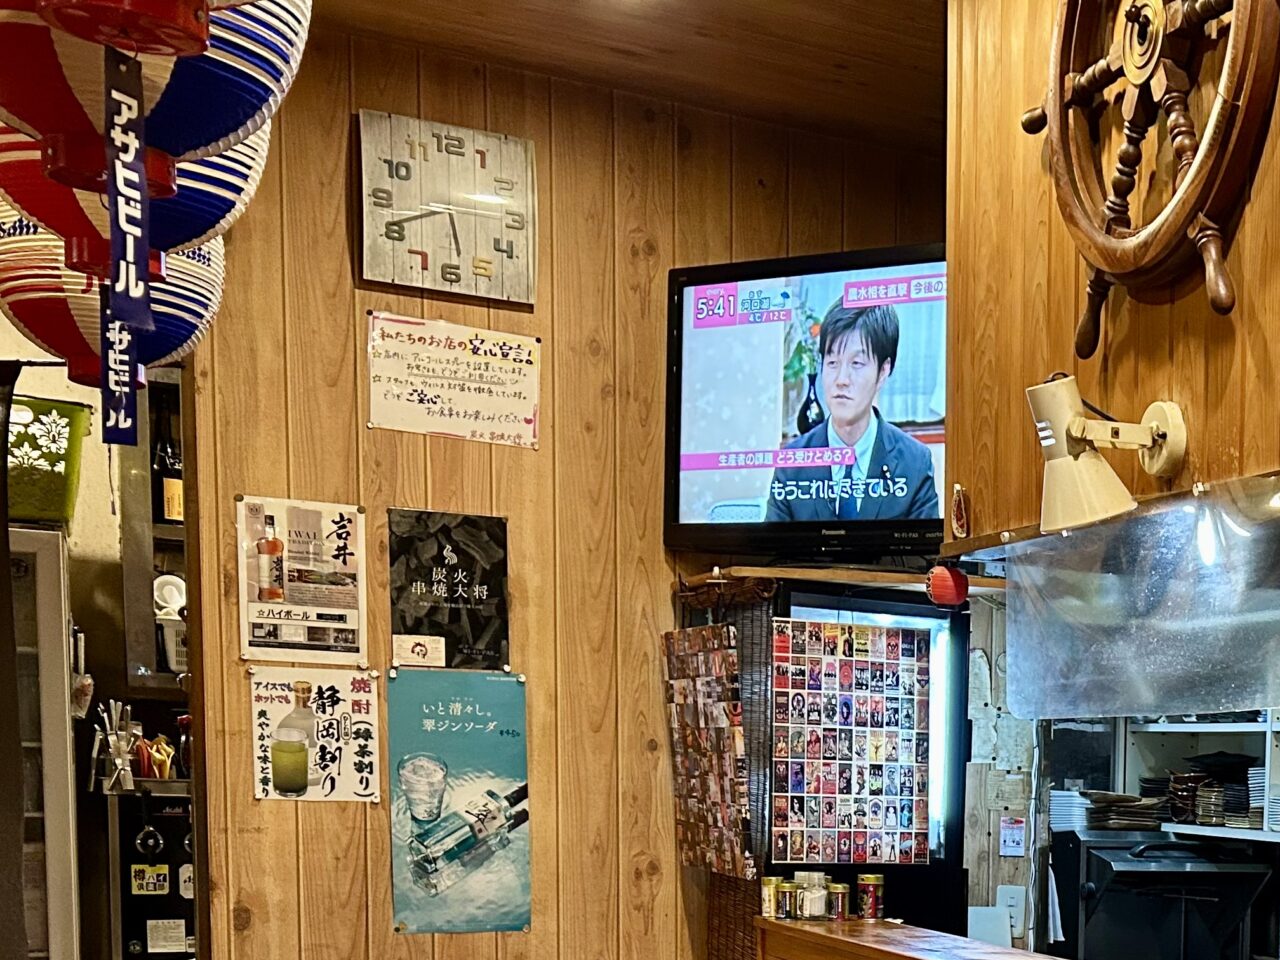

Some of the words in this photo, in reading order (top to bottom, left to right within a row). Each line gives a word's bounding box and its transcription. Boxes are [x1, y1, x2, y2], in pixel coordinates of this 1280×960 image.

[405, 138, 430, 162] 11
[432, 133, 465, 157] 12
[383, 158, 412, 181] 10
[475, 148, 487, 169] 1
[110, 90, 145, 298] アサヒビール
[371, 187, 393, 208] 9
[494, 177, 514, 198] 2
[505, 209, 525, 231] 3
[385, 221, 406, 242] 8
[407, 248, 429, 270] 7
[493, 238, 514, 260] 4
[441, 262, 462, 284] 6
[472, 256, 494, 278] 5
[696, 294, 736, 320] 5:41
[771, 477, 908, 501] もうこれに尽きている
[326, 512, 356, 566] 岩井
[431, 567, 469, 583] 炭火
[411, 581, 489, 600] 串焼大将
[266, 608, 311, 621] ハイボール
[254, 681, 294, 693] アイスでも
[350, 676, 372, 715] 焼酎
[254, 694, 291, 704] ホットでも
[422, 701, 493, 717] いと清々し。
[422, 718, 499, 732] 翠ジンソーダ
[310, 684, 347, 798] 静岡割り
[256, 708, 272, 798] 爽やかな味と香り
